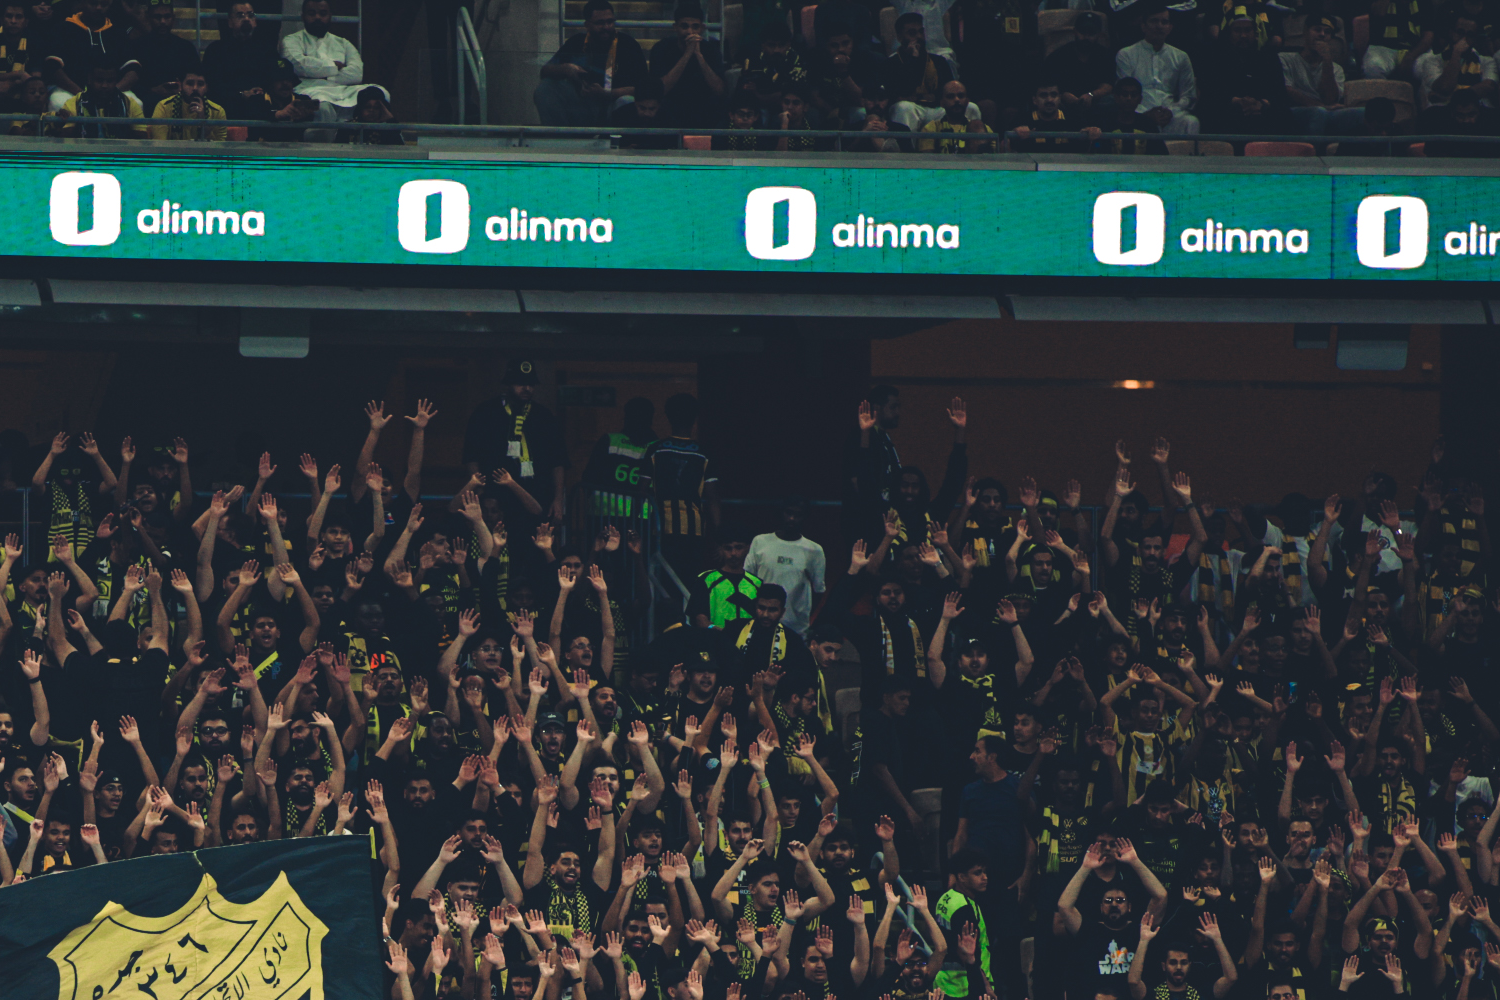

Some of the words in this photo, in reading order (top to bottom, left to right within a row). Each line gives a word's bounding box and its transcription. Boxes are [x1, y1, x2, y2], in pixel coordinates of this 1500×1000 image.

[137, 200, 265, 236] alinma
[485, 208, 613, 243] alinma
[832, 214, 959, 248] alinma
[1181, 219, 1308, 253] alinma
[1444, 222, 1500, 256] alin
[259, 931, 287, 989] نادي
[1099, 963, 1132, 975] WAR
